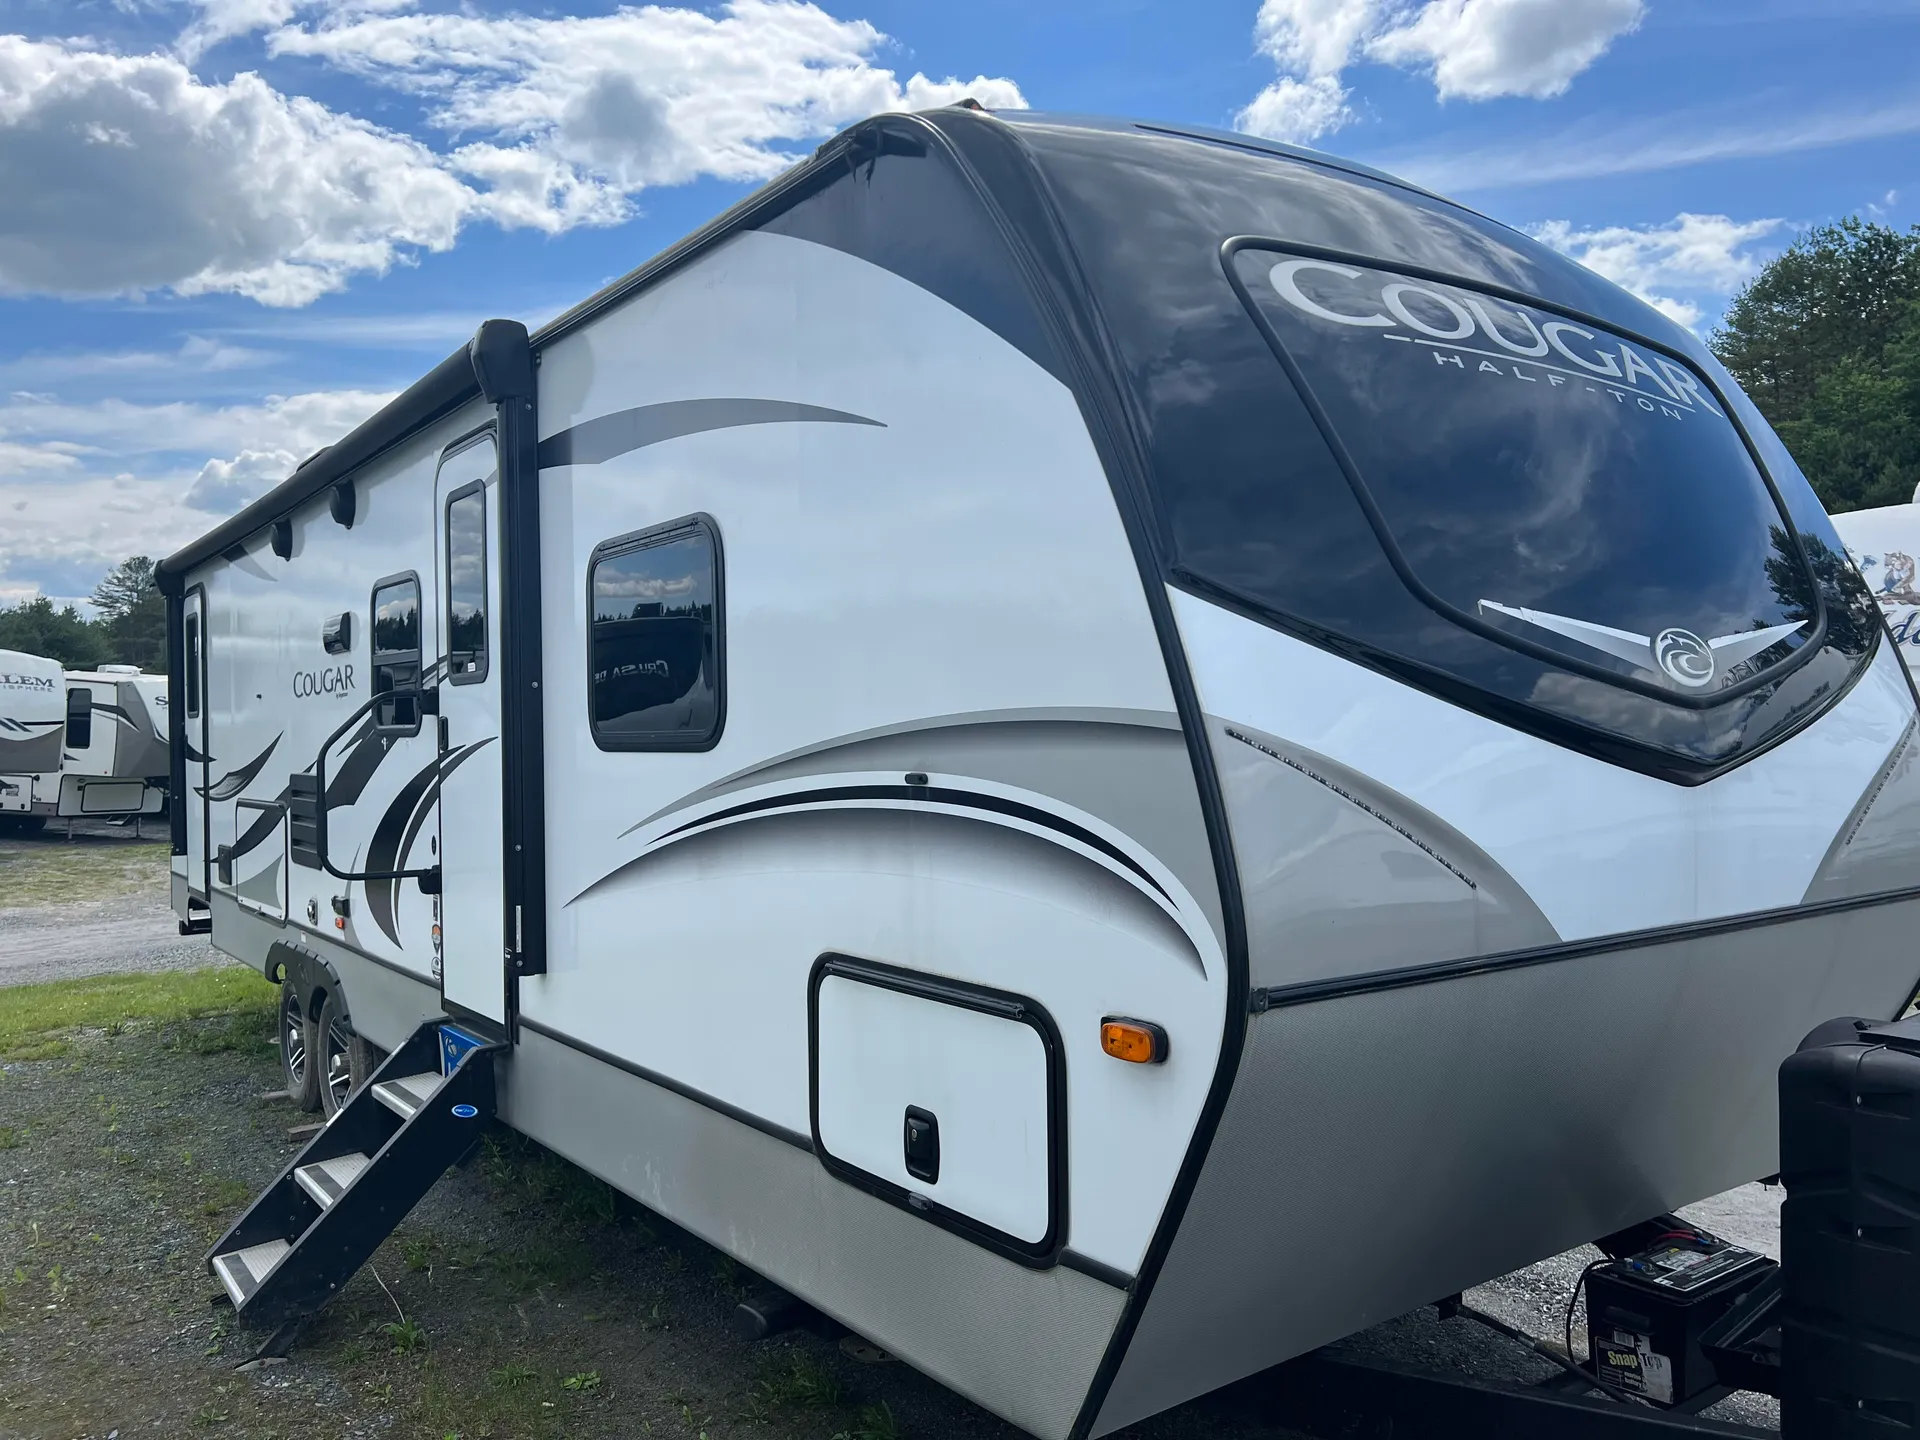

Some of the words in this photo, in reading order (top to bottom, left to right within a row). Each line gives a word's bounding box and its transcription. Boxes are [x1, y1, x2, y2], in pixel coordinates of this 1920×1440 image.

[1268, 259, 1724, 418] COUGAR
[0, 674, 56, 688] LEM
[293, 664, 356, 699] COUGAR
[1607, 1350, 1638, 1369] Snap
